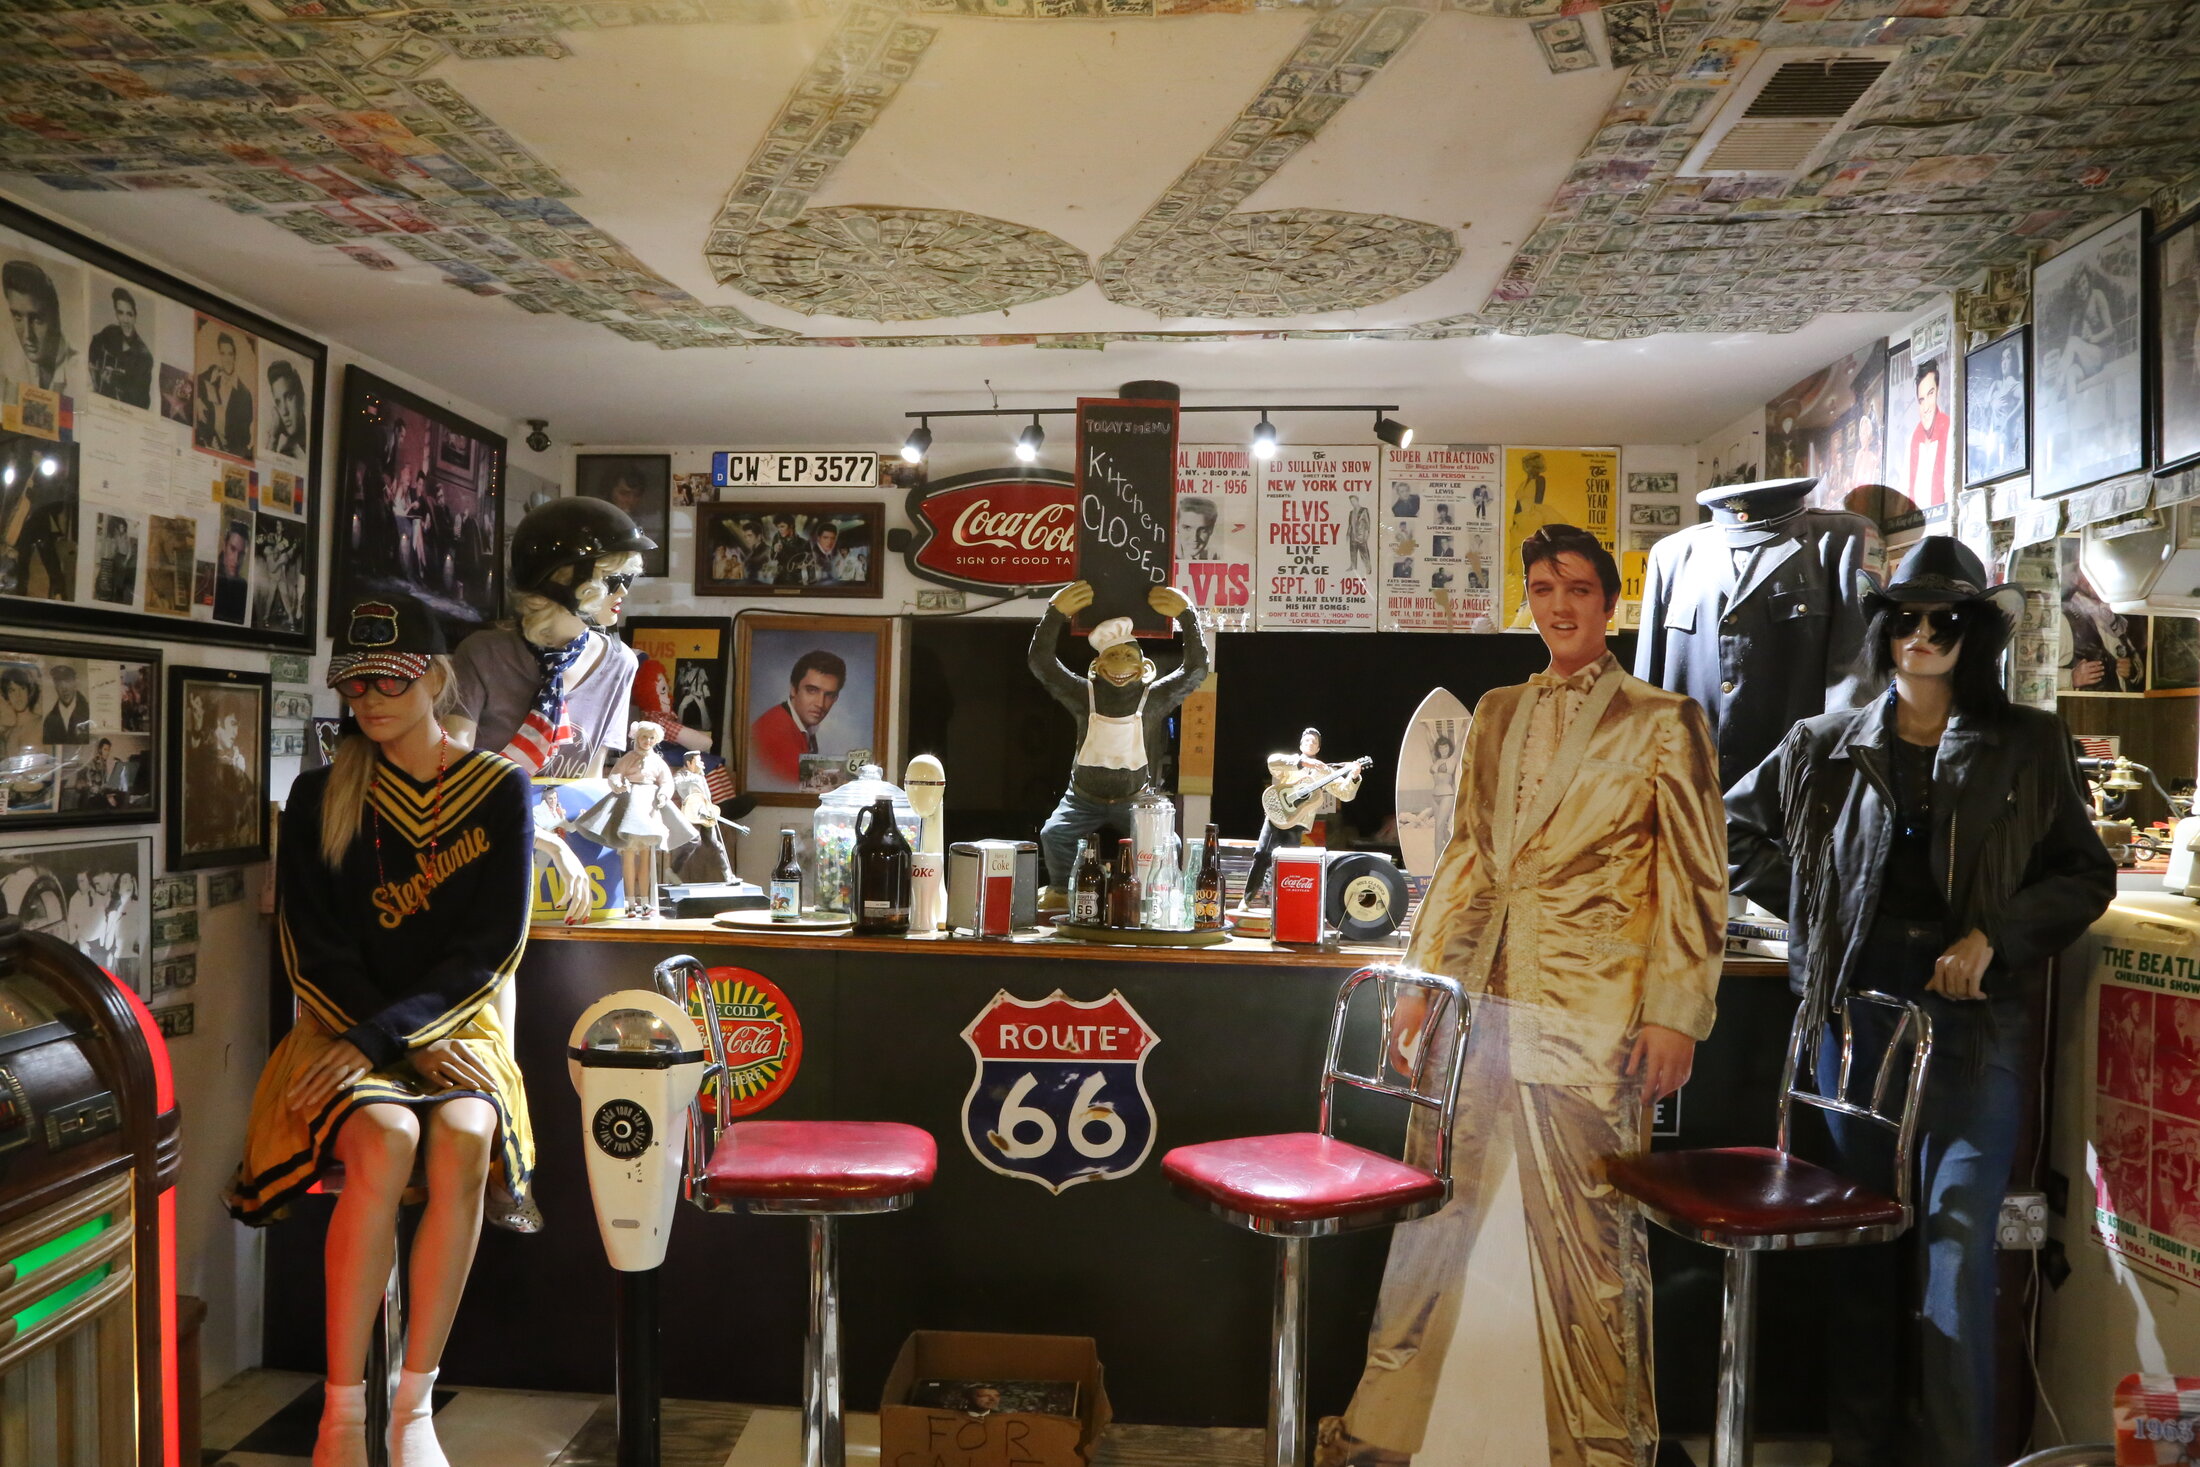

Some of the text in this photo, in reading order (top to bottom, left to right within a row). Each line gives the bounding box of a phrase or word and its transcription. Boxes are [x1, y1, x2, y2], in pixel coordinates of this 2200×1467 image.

[1179, 451, 1250, 468] AL AUDITORIUM
[1390, 450, 1495, 464] SUPER ATTRACTIONS
[730, 456, 760, 482] CW
[778, 456, 808, 482] EP
[814, 456, 874, 482] 3577
[1270, 461, 1372, 473] ED SULLIVAN SHOW
[1202, 480, 1213, 494] 21
[1224, 480, 1248, 494] 1956
[1268, 480, 1372, 492] NEW YORK CITY
[1586, 478, 1610, 493] SEVEN
[1588, 494, 1608, 509] YEAR
[1282, 500, 1330, 522] ELVIS
[1588, 510, 1606, 524] ITCH
[952, 499, 1075, 553] Coca-Col
[1270, 523, 1341, 545] PRESLEY
[1082, 494, 1166, 583] CLOSED
[1286, 546, 1320, 554] LIVE
[956, 556, 985, 565] SIGN
[991, 556, 1007, 565] OF
[1012, 556, 1050, 565] GOOD
[1294, 556, 1314, 564] ON
[1278, 566, 1329, 575] STAGE
[1176, 562, 1249, 606] VIS
[1272, 577, 1308, 594] SEPT.
[1315, 578, 1326, 594] 10
[1626, 578, 1640, 596] 11
[1388, 597, 1412, 608] HILTON
[1416, 598, 1436, 609] HOTEL
[1462, 598, 1491, 611] ANGELES
[992, 860, 1010, 871] Coke
[372, 826, 490, 929] Stephanie
[1281, 876, 1314, 888] Coca-Cola
[534, 865, 608, 911] LVS
[1078, 904, 1092, 914] 66
[1760, 927, 1783, 939] WITH
[2102, 946, 2200, 981] THE BEATL
[2114, 970, 2166, 988] CHRISTMAS
[724, 1006, 758, 1017] COLD
[1000, 1024, 1118, 1051] ROUTE
[730, 1069, 764, 1086] HERE
[600, 1106, 645, 1127] LOCK YOUR CAR
[998, 1071, 1126, 1159] 66
[1653, 1104, 1664, 1124] E
[614, 1142, 632, 1152] YOUR
[2108, 1214, 2138, 1238] ASTORIA
[2148, 1232, 2187, 1259] FINSBURY
[2190, 1249, 2200, 1264] PA
[2125, 1240, 2146, 1258] 1963
[2156, 1254, 2176, 1270] Jan.
[927, 1415, 1032, 1457] FOR
